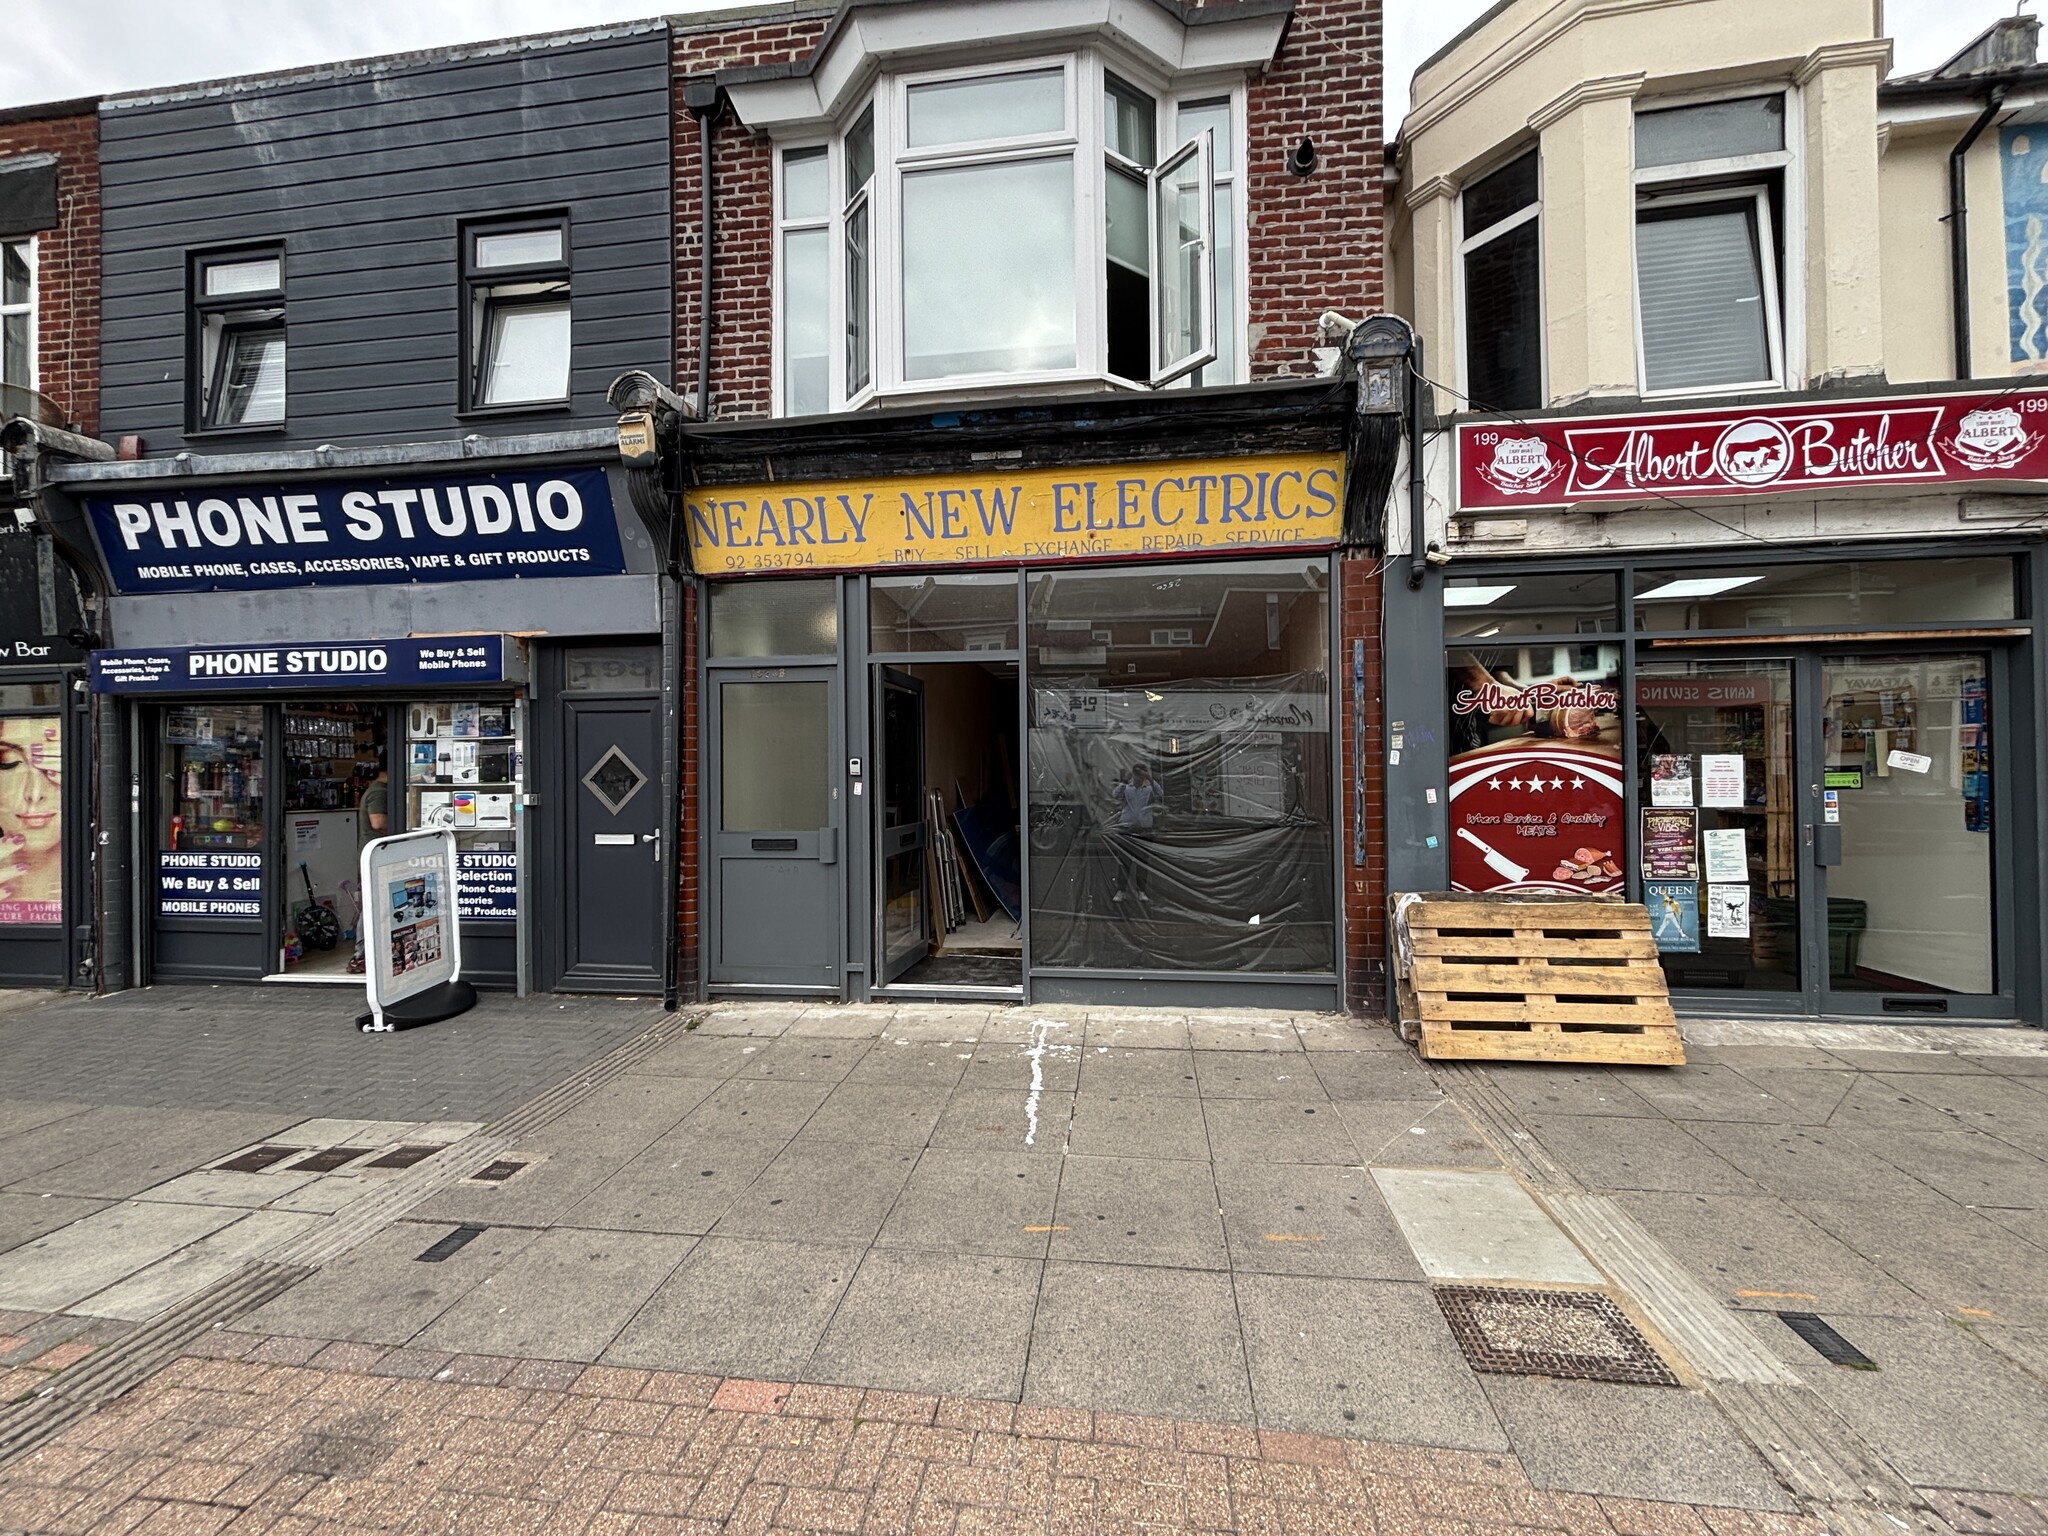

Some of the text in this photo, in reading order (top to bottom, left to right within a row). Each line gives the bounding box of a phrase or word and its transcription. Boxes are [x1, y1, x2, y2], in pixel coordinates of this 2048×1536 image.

[2017, 398, 2048, 413] 199
[1962, 426, 2017, 438] ALBERT
[1473, 432, 1499, 446] 199
[1576, 413, 1928, 490] Albert Butcher
[1497, 454, 1543, 465] ALBERT
[1967, 453, 2016, 463] Butcher Shop
[1500, 479, 1542, 489] Butcher Shop
[688, 468, 1338, 548] NEARLY NEW ELECTRICS
[113, 479, 583, 551] PHONE STUDIO
[894, 548, 926, 563] BUY
[955, 544, 993, 560] SELL
[1023, 537, 1113, 557] EXCHANGE
[1141, 532, 1204, 551] REPAIR
[137, 548, 590, 579] MOBILE PHONE, CASES, ACCESSORIES, VAPE & GIFT PRODUCTS
[725, 551, 814, 569] 92 353794
[15, 641, 51, 657] Bar
[420, 647, 485, 659] We Buy & Sell
[100, 657, 171, 667] Mobile Phone, Cases,
[189, 649, 388, 676] PHONE STUDIO
[419, 659, 487, 670] Mobile Phones
[145, 665, 162, 674] Vape
[163, 665, 171, 673] &
[114, 674, 159, 683] Gift Products
[1452, 682, 1617, 715] Albert Butcher
[1899, 755, 1921, 765] OPEN
[1466, 813, 1607, 828] Where Service & Quality
[1516, 825, 1557, 836] MEATS
[1657, 822, 1680, 832] VIBES
[161, 855, 261, 867] PHONE STUDIO
[463, 854, 517, 867] STUDIO
[457, 870, 513, 882] Selection
[161, 876, 261, 893] We Buy & Sell
[457, 885, 517, 894] Phone Cases
[1648, 885, 1693, 897] QUEEN
[458, 896, 494, 905] ssories
[161, 901, 260, 914] MOBILE PHONES
[474, 906, 517, 917] Products
